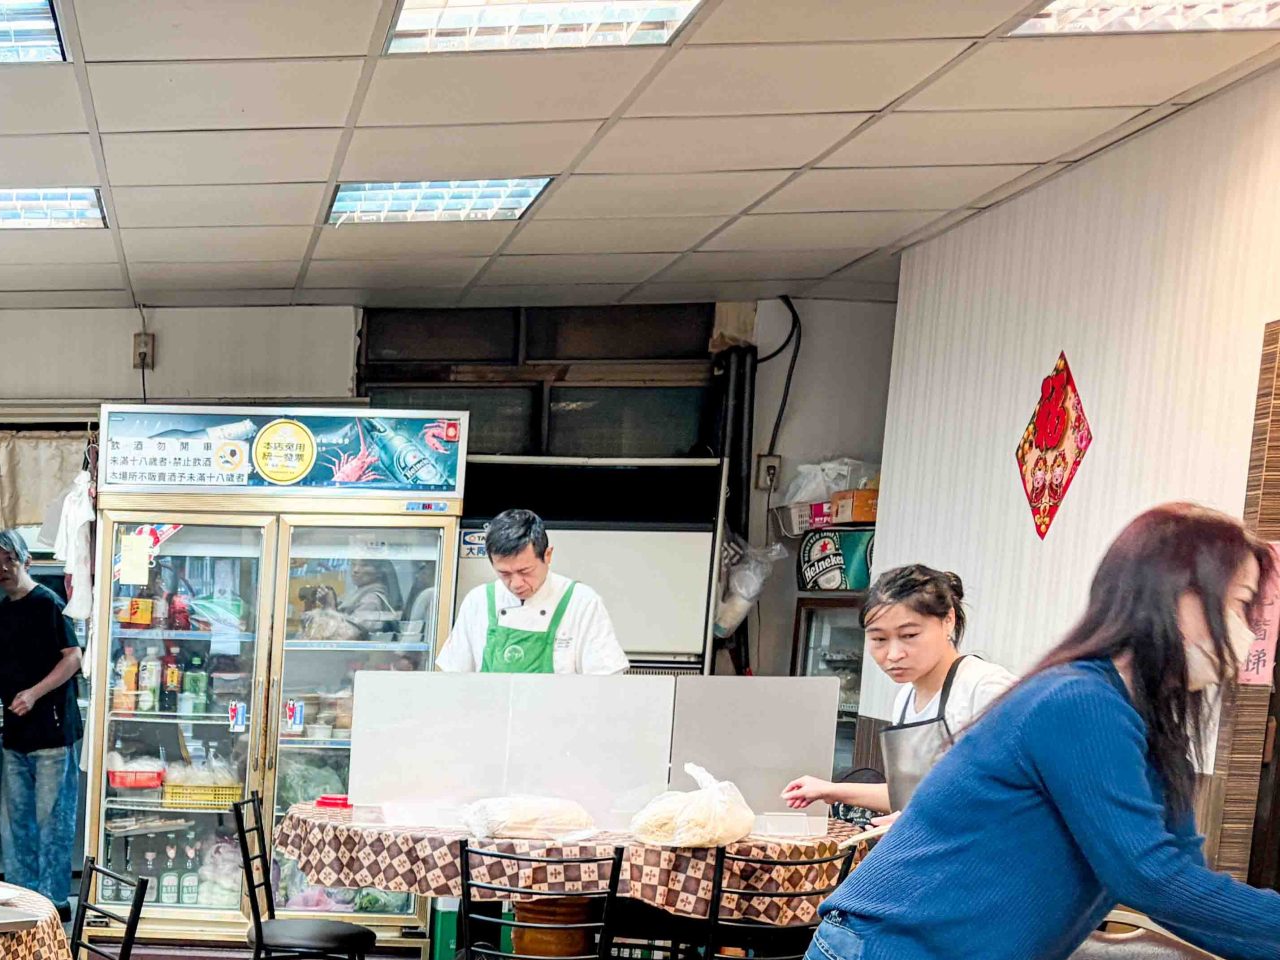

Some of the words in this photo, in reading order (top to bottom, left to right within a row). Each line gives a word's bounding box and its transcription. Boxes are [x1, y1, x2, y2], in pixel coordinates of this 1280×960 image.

[110, 441, 212, 452] 飲酒勿開車
